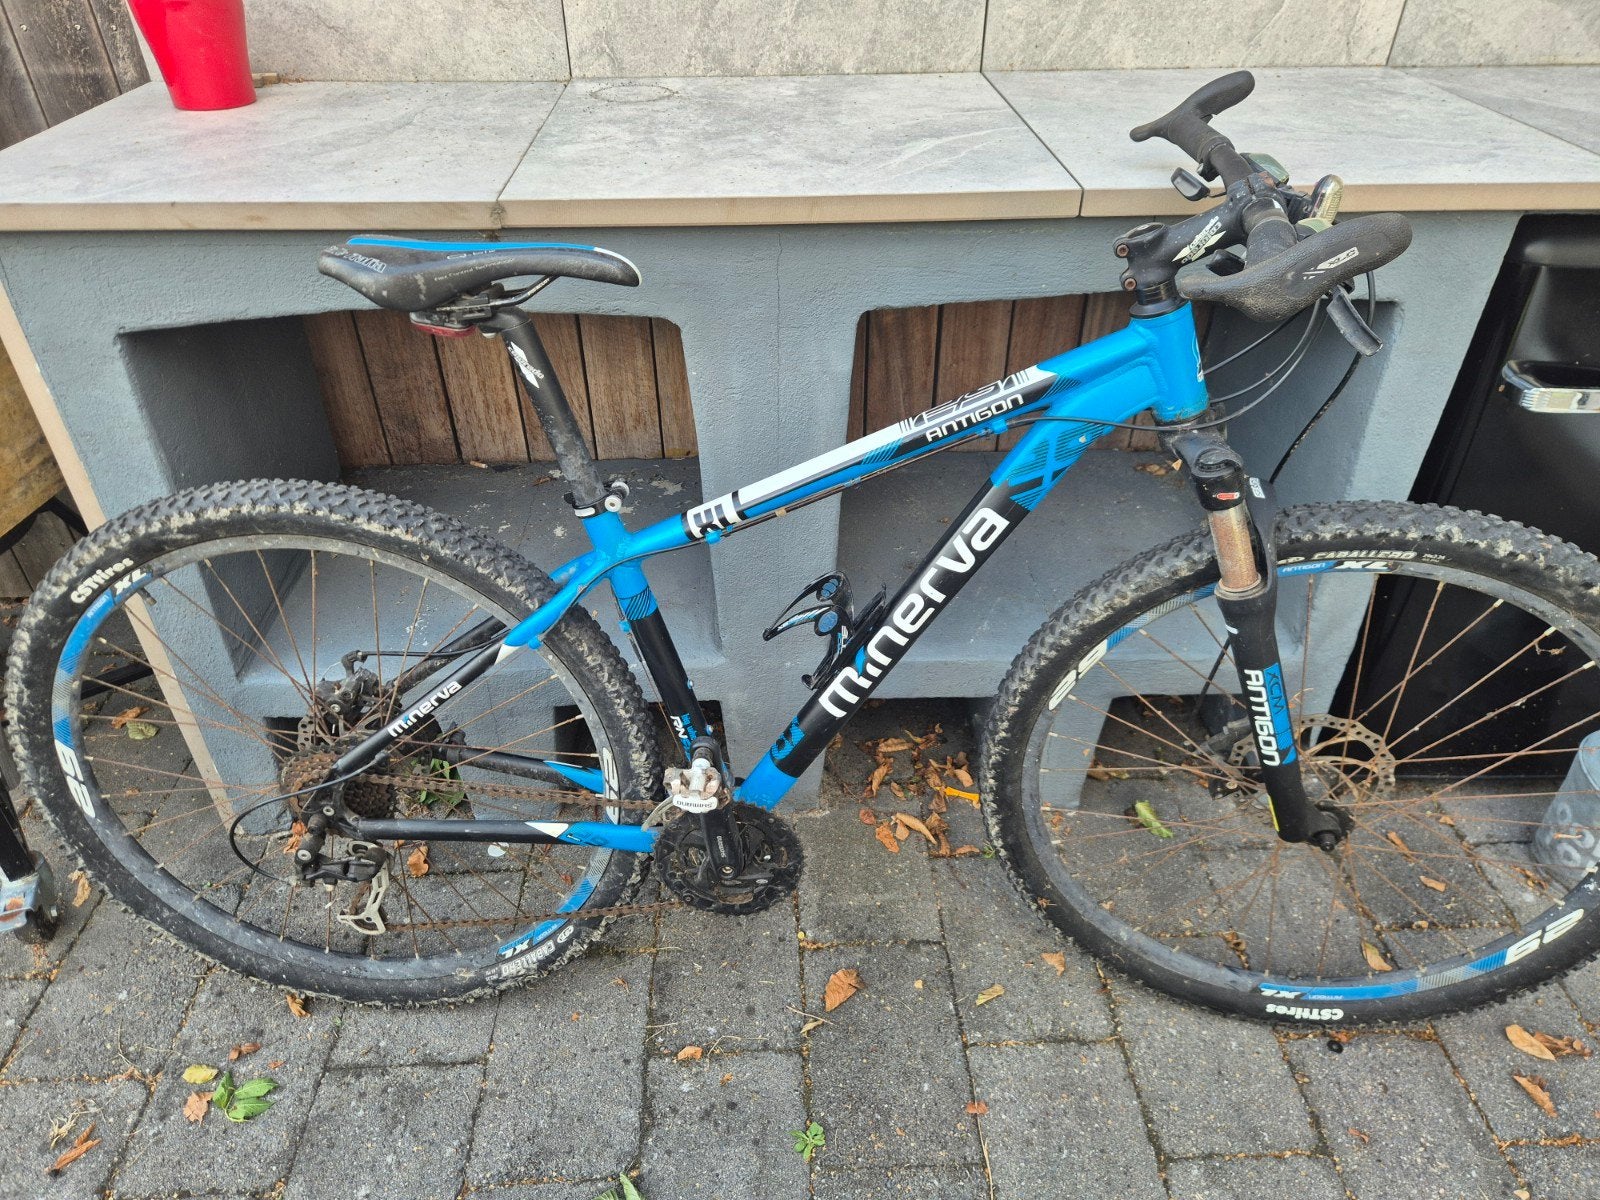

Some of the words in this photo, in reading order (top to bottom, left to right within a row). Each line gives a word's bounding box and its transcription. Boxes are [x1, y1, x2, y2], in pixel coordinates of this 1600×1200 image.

[924, 392, 1025, 442] ANTIGON
[1312, 549, 1418, 561] CABALLERO
[818, 506, 1010, 719] minerva
[386, 680, 462, 738] minerva
[1243, 668, 1281, 767] ANTIGON
[1266, 670, 1286, 714] XCM
